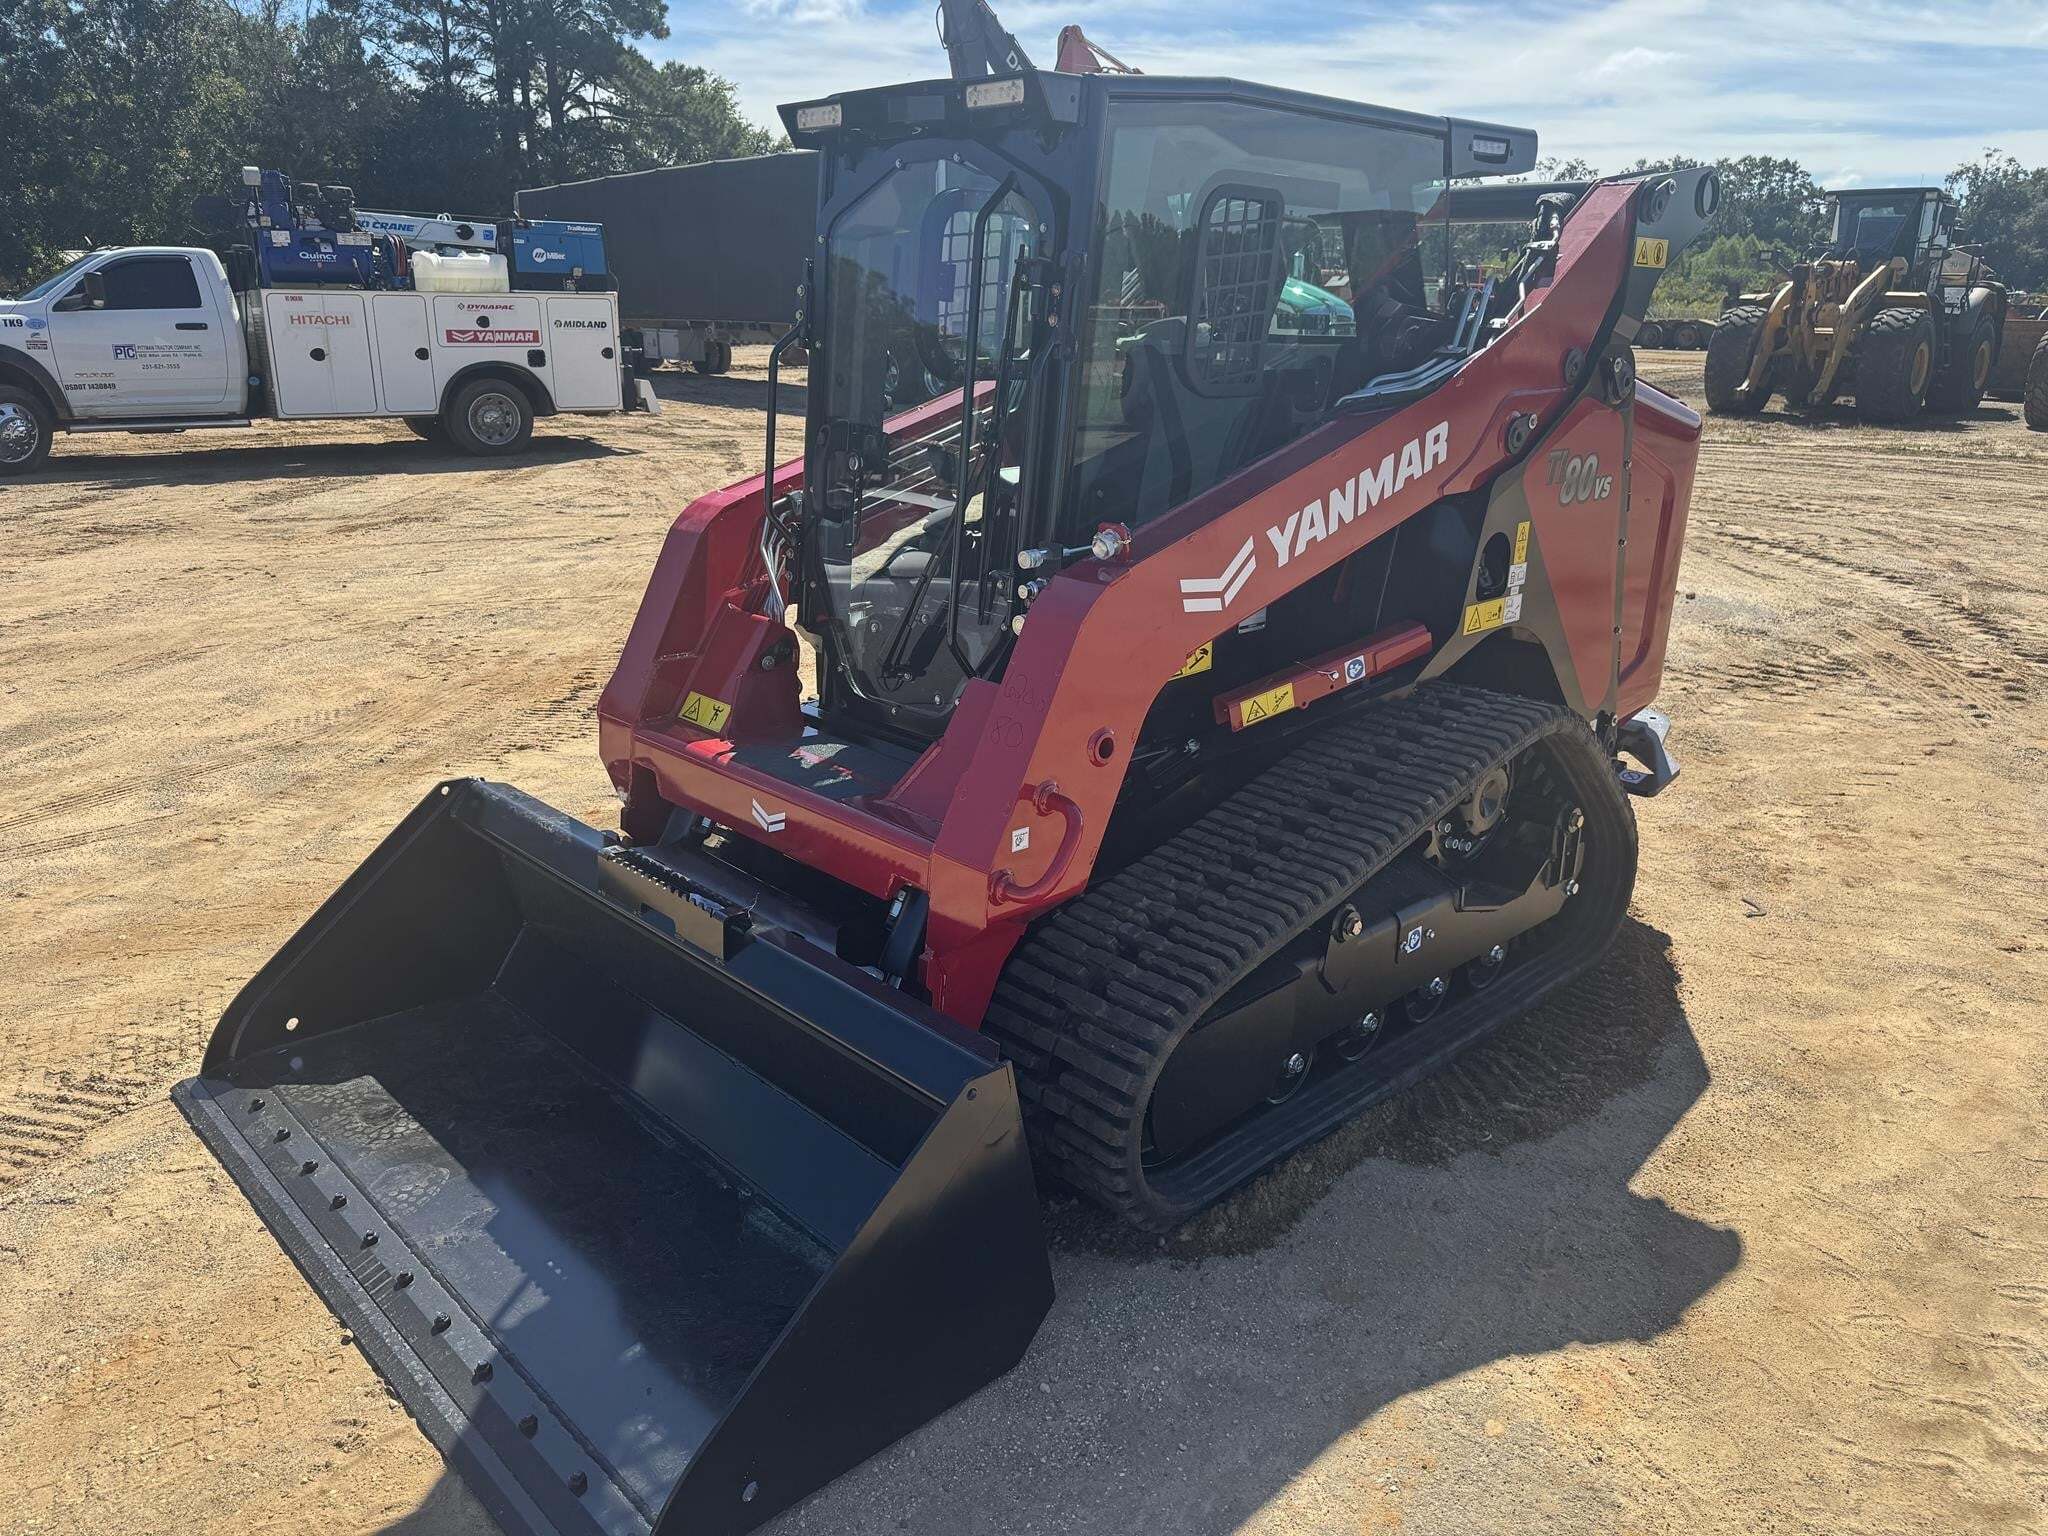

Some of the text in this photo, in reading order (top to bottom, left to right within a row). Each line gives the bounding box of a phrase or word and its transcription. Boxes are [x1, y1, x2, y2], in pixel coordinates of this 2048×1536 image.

[372, 221, 415, 232] CRANE
[299, 251, 337, 260] Quincy
[547, 251, 566, 260] Miller
[2, 318, 23, 327] TK9
[290, 315, 351, 325] HITACHI
[563, 320, 607, 329] MIDLAND
[476, 331, 534, 342] YANMAR
[114, 346, 136, 360] PTC
[65, 383, 87, 391] USDOT
[1266, 421, 1449, 567] YANMAR
